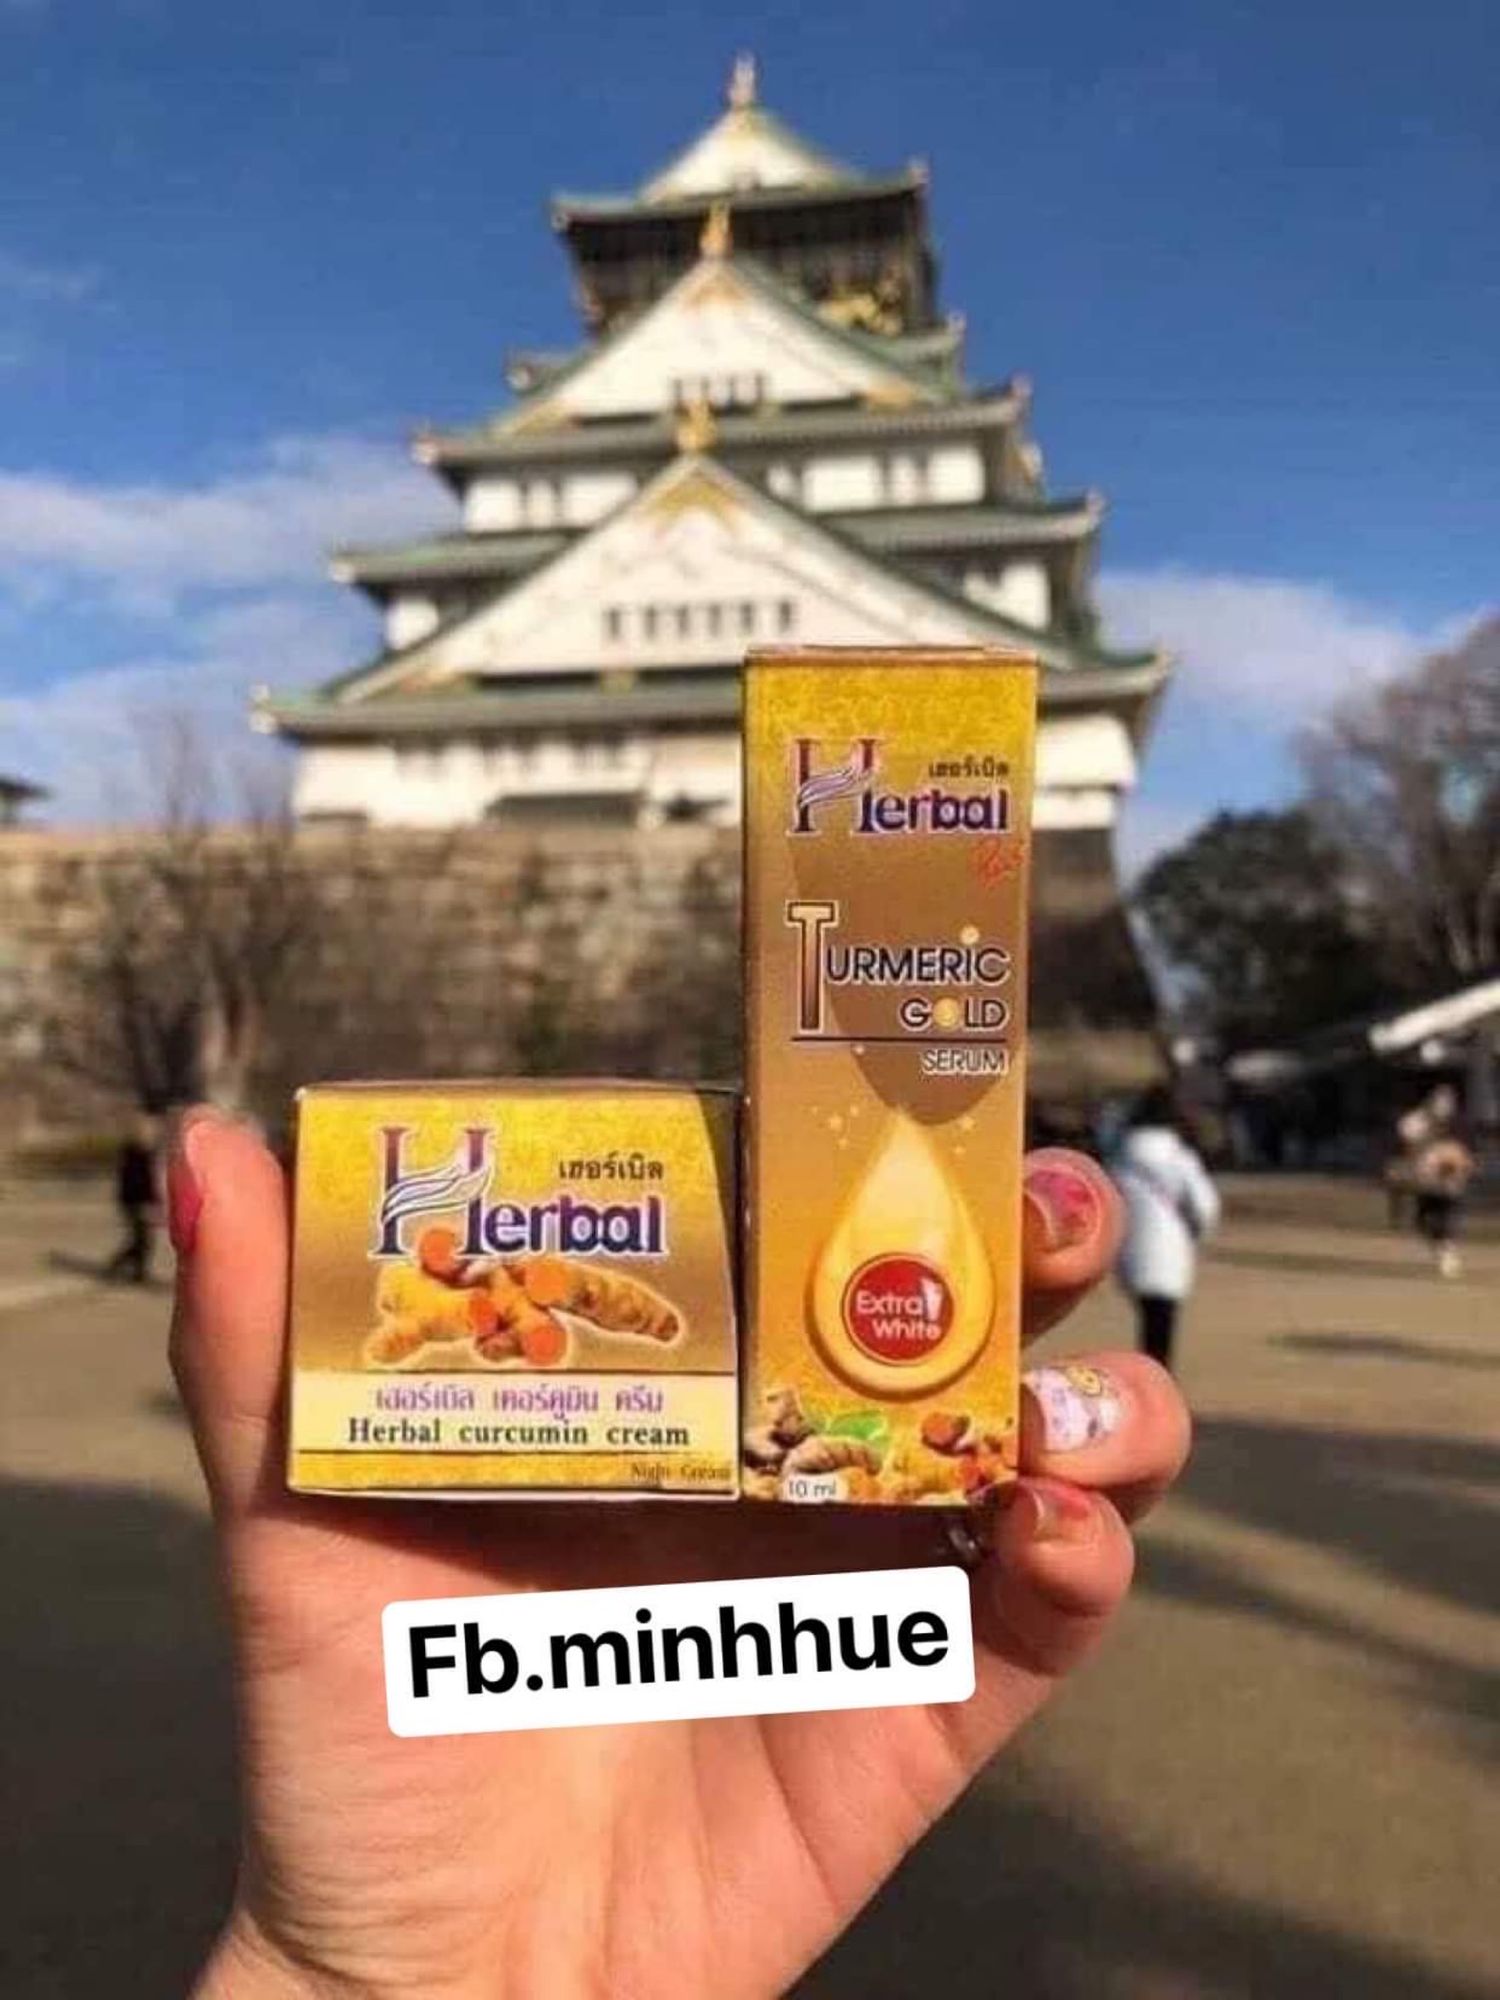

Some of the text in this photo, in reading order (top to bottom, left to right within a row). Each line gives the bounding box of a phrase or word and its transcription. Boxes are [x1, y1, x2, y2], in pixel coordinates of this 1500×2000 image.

[793, 738, 1008, 834] Herbal
[786, 900, 1010, 1031] TURMERIC
[921, 1047, 1007, 1076] SERUM
[375, 1126, 665, 1256] Herbal
[855, 1289, 924, 1316] Extra
[873, 1318, 943, 1341] White
[348, 1417, 690, 1446] Herbal curcumin cream
[787, 1481, 808, 1498] 10
